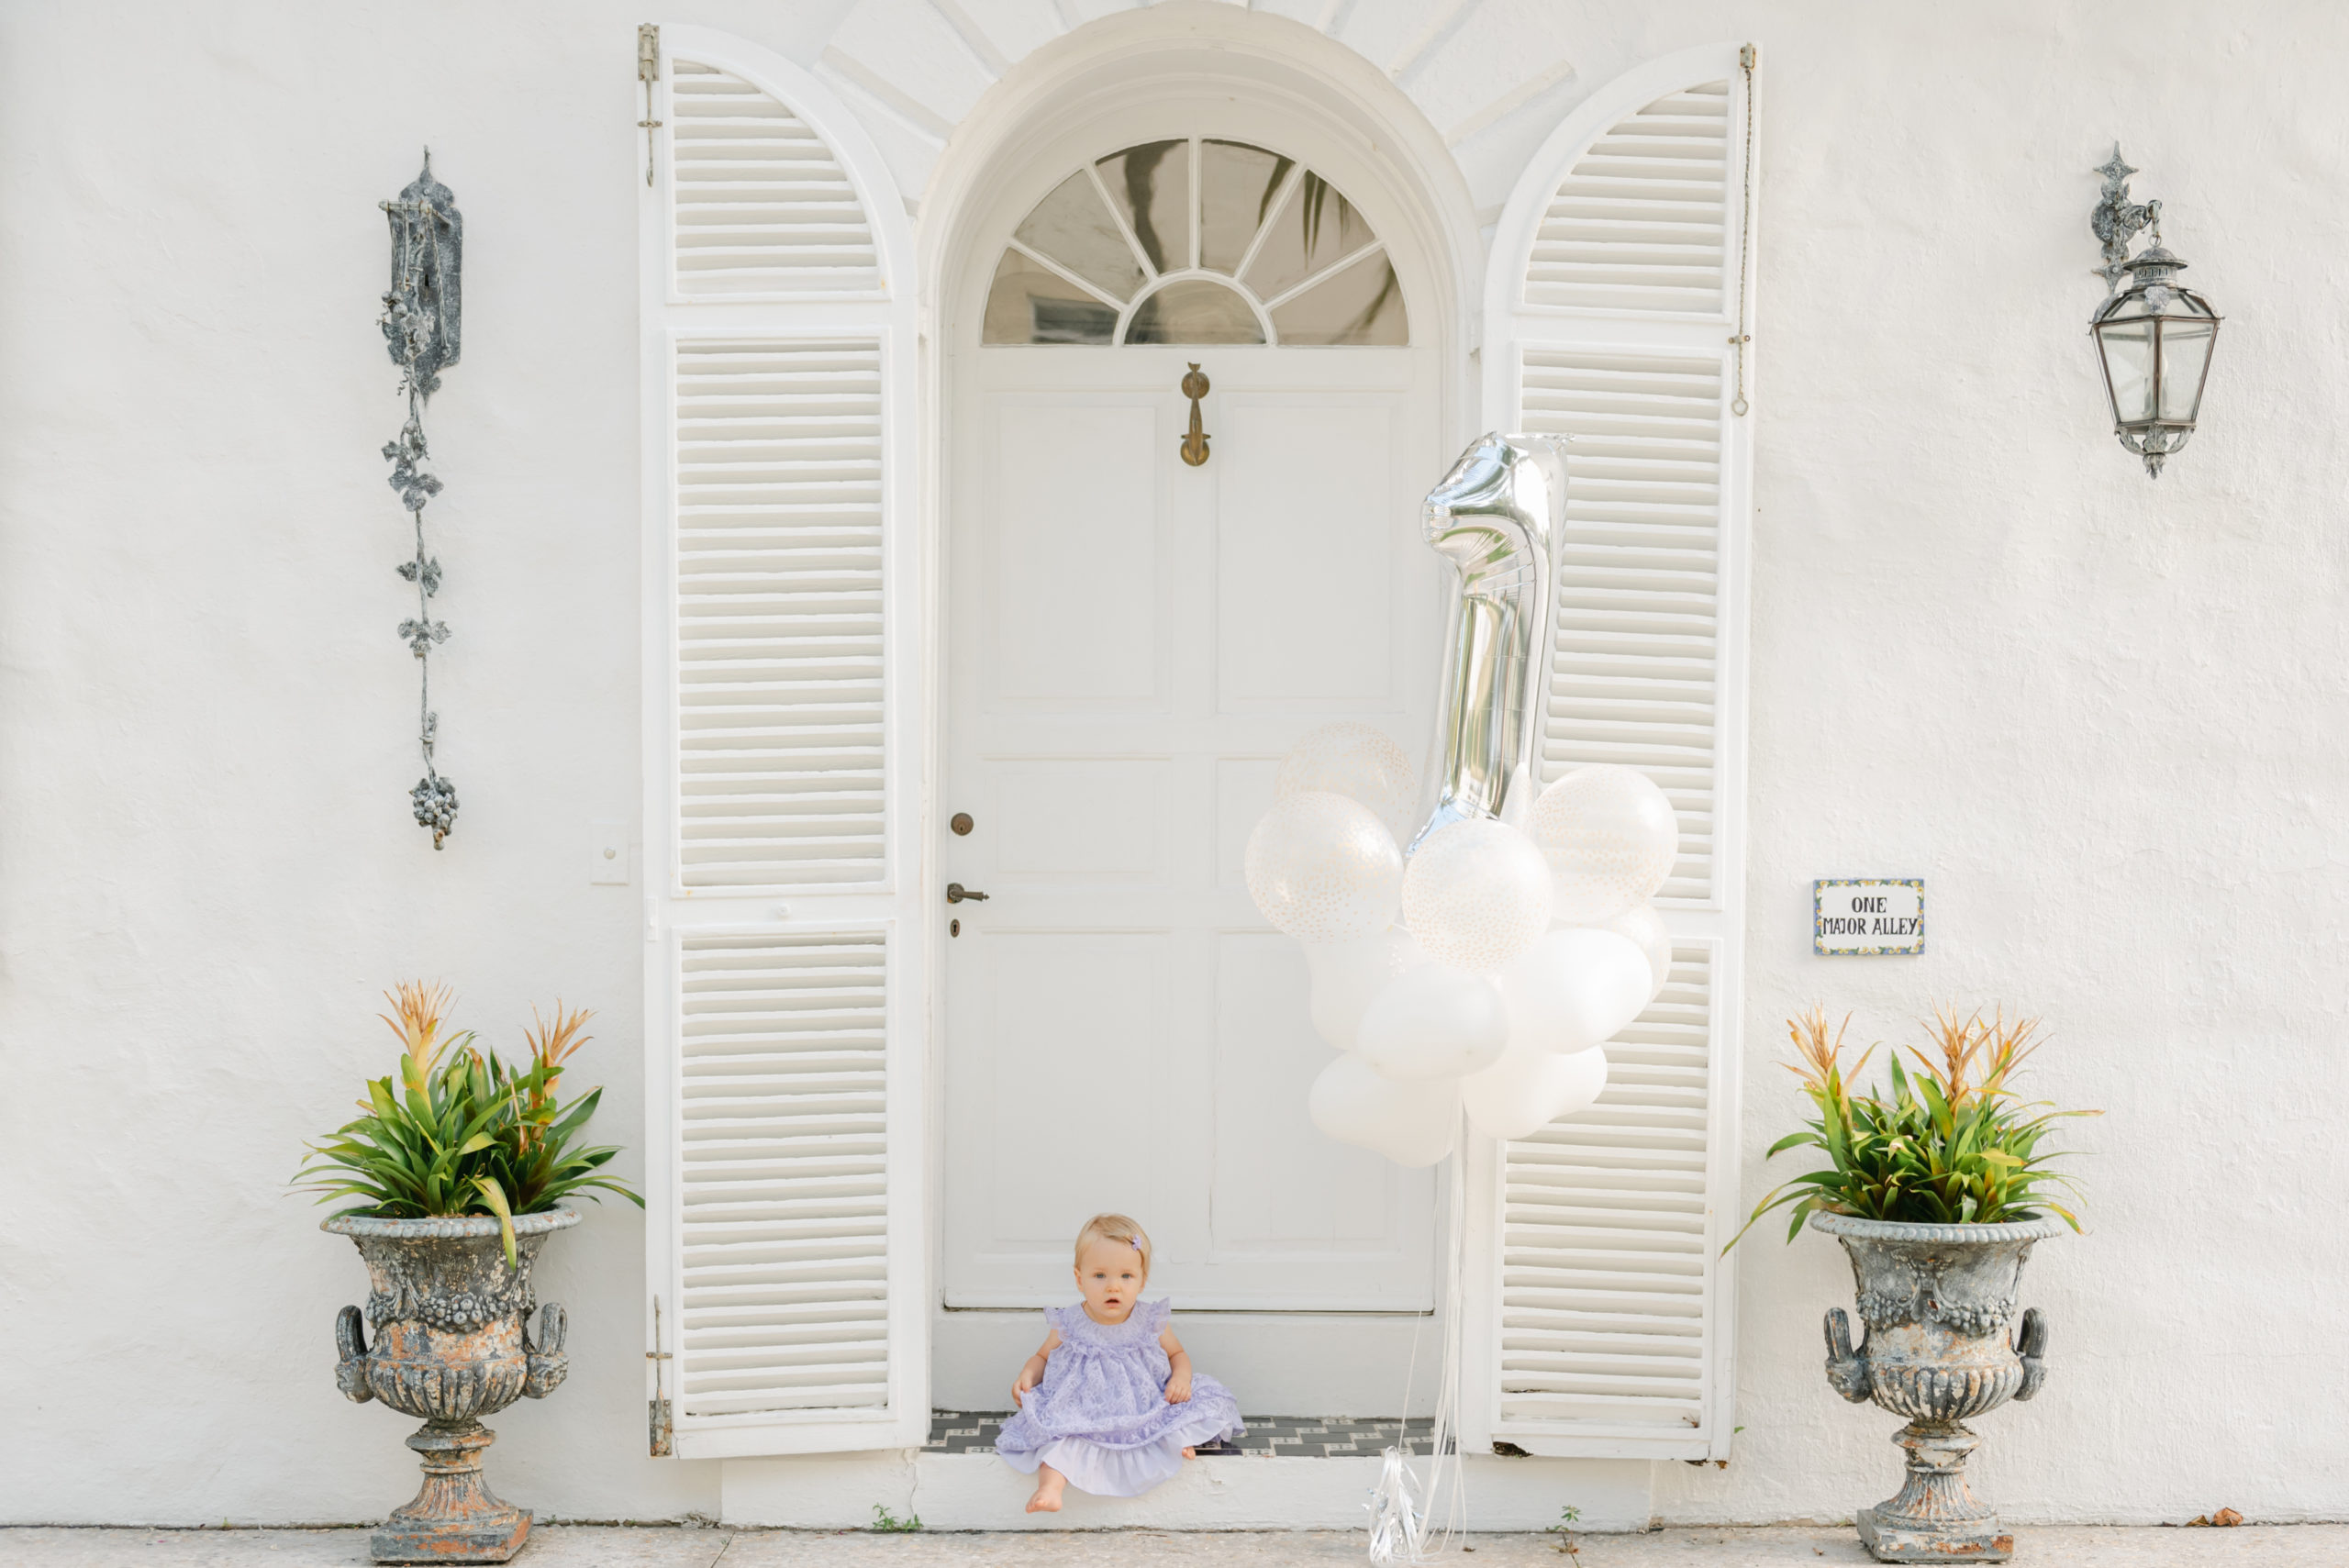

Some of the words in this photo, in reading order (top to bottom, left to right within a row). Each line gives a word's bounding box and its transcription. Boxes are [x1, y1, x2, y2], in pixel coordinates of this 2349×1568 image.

[1852, 896, 1887, 913] ONE
[1822, 917, 1866, 935] MAJOR
[1872, 917, 1918, 935] ALLEY
